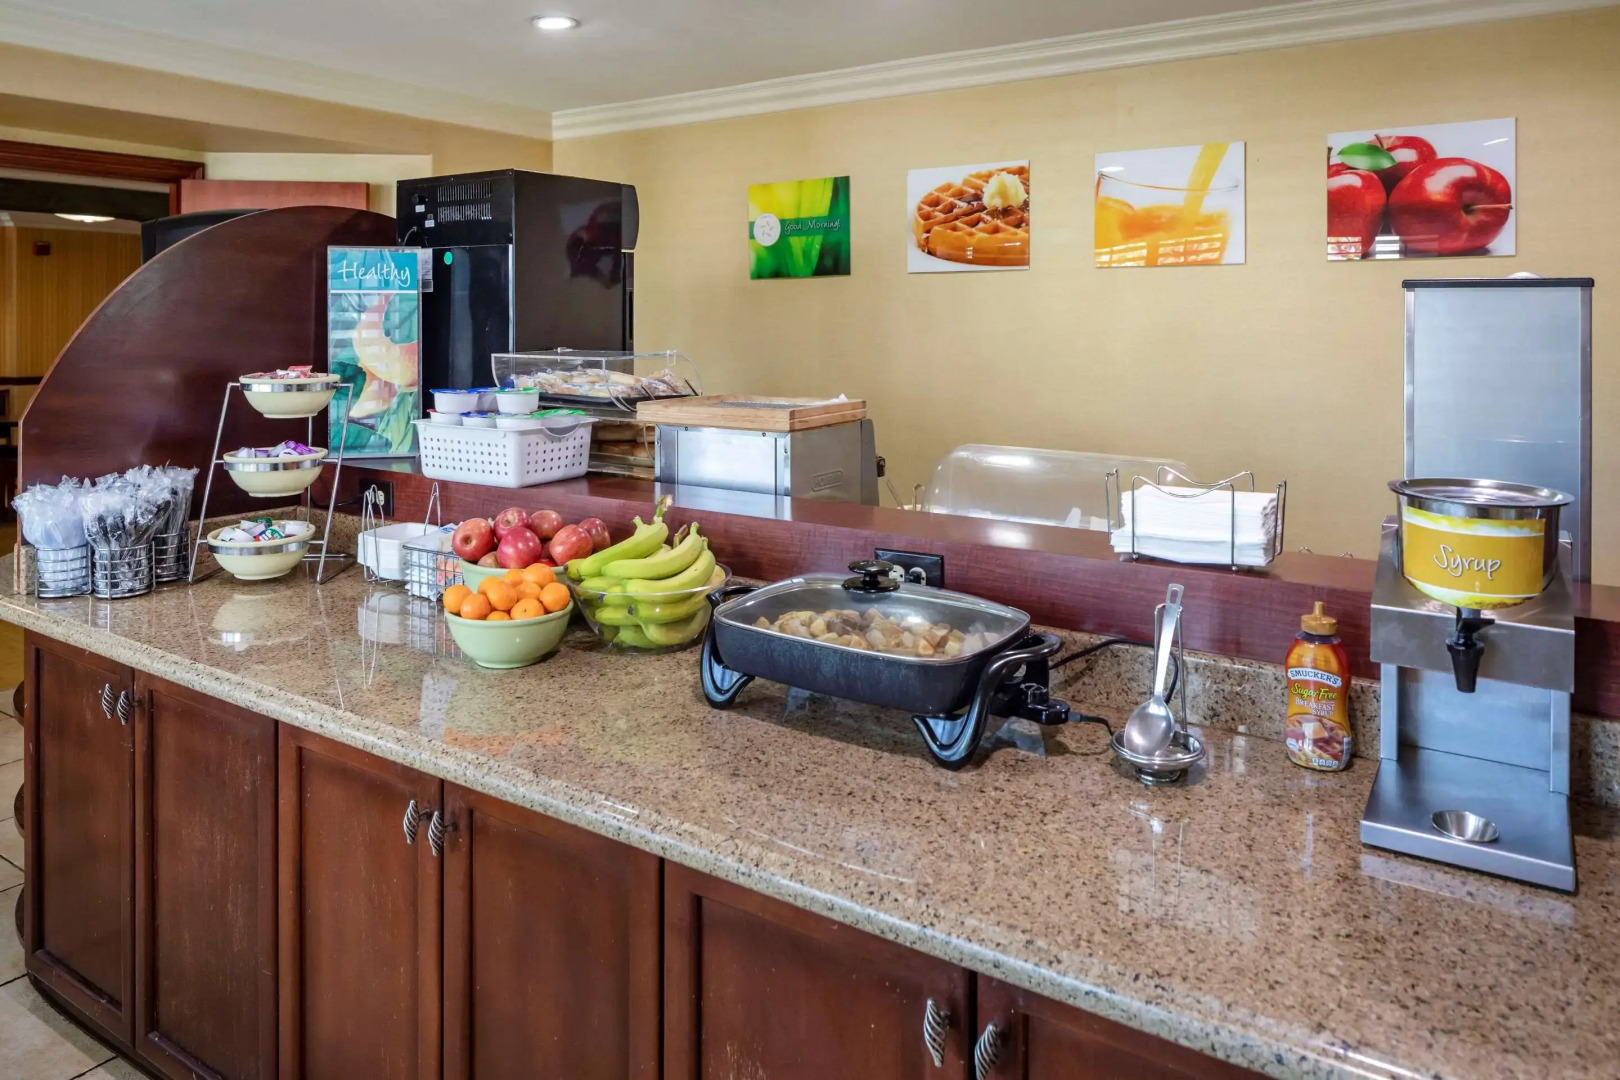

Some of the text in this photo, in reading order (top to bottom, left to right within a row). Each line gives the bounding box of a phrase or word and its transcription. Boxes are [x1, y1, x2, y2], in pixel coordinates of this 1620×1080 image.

[784, 219, 841, 235] Good Morning!
[338, 260, 411, 287] Healthy
[1433, 544, 1501, 580] Syrup
[1289, 669, 1339, 685] SMUCKER'S
[1291, 682, 1337, 700] Sugar Free
[1295, 697, 1336, 710] BREAKFAST
